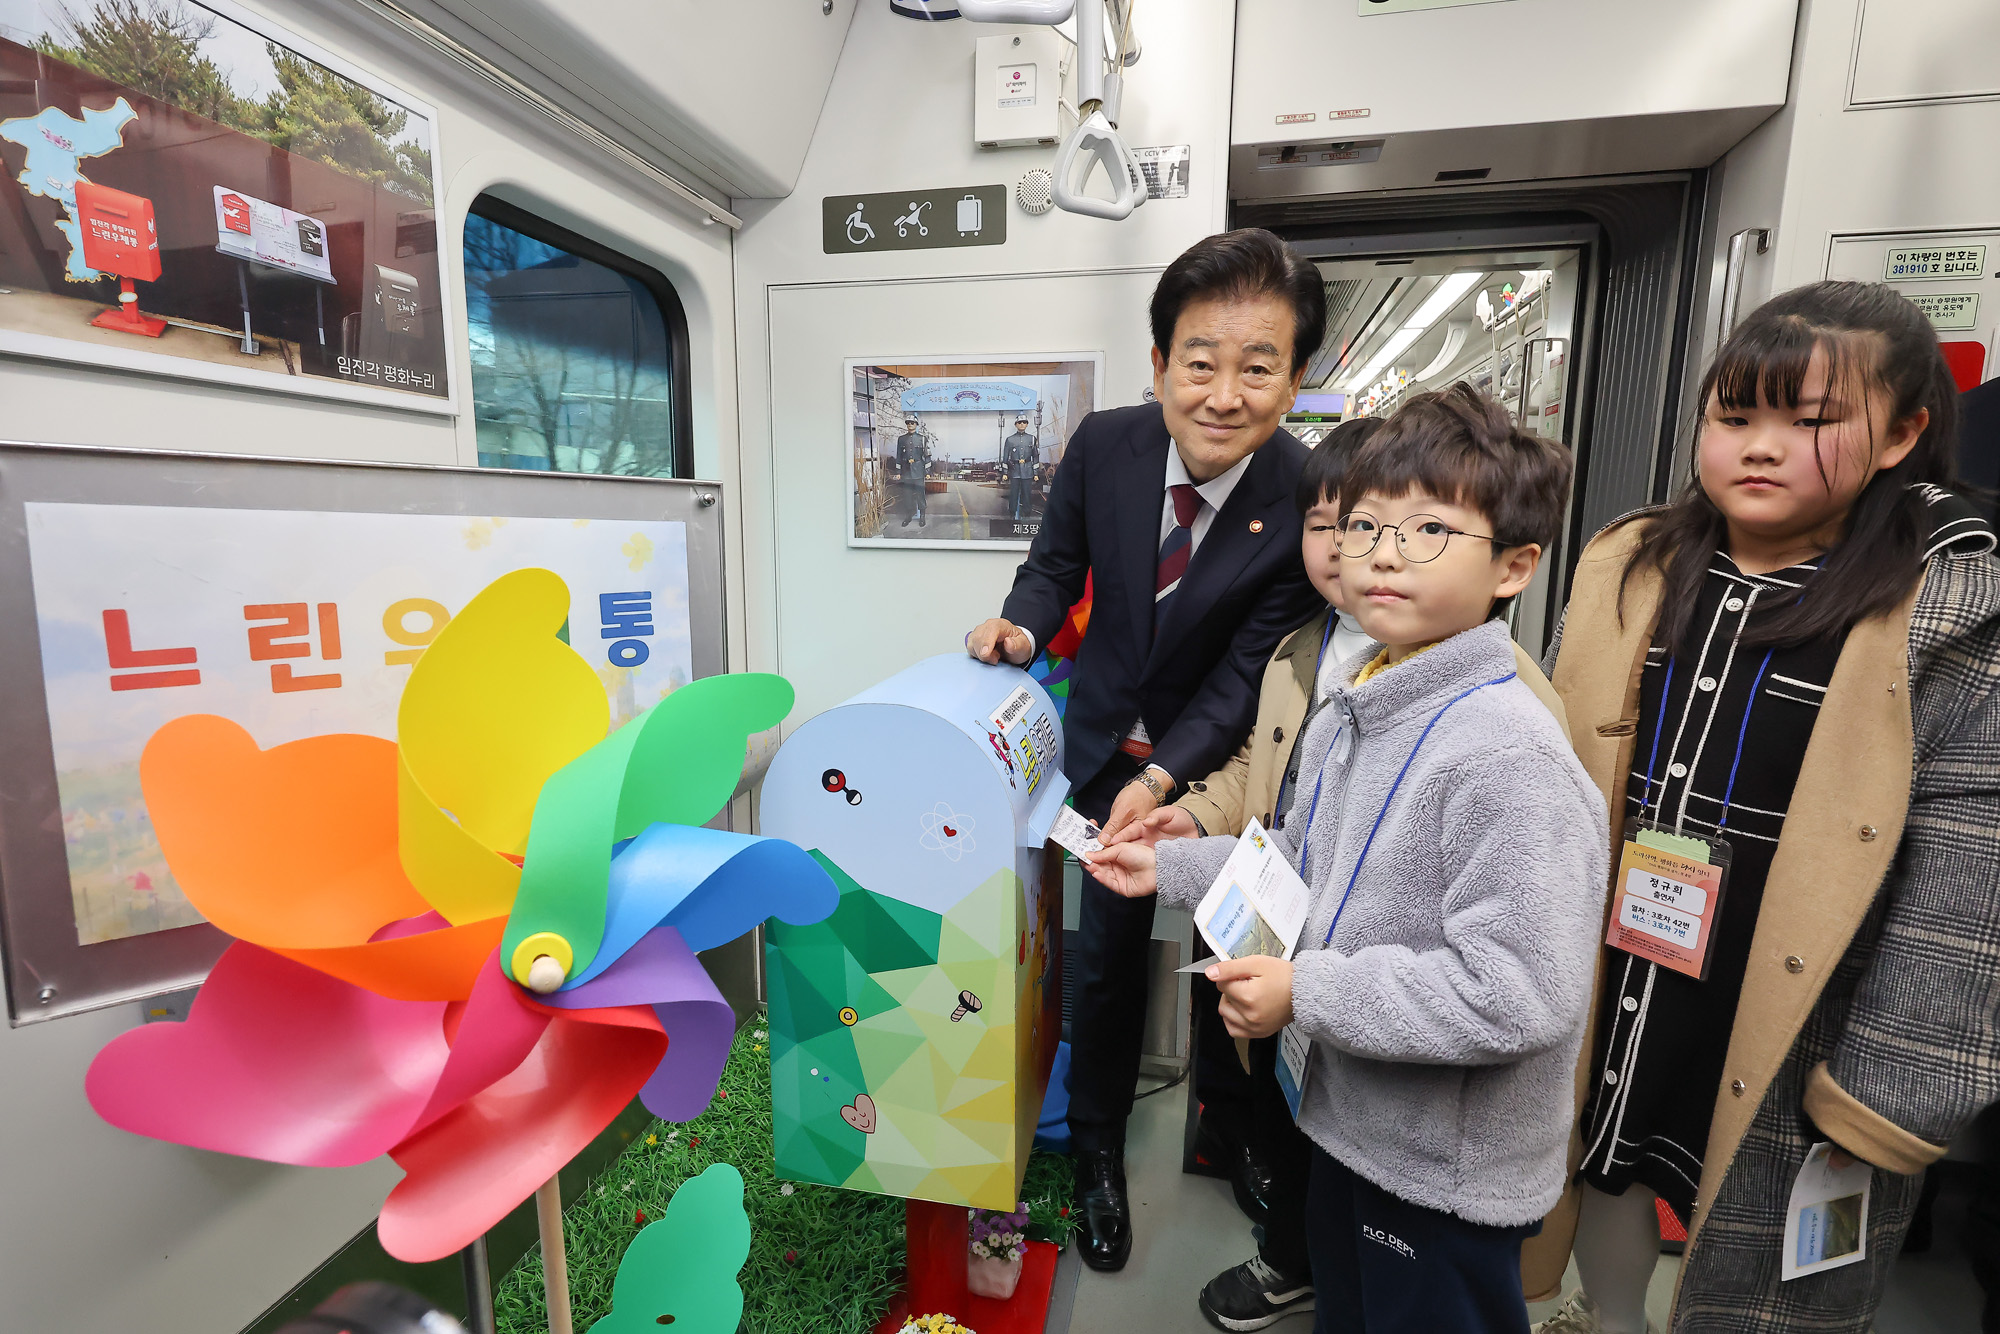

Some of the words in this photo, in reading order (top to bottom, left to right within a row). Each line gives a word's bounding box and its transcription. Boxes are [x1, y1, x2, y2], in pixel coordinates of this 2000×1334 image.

[92, 227, 138, 248] 느린우체통
[1896, 254, 1906, 262] 이
[1910, 252, 1941, 261] 차량의
[1945, 251, 1977, 261] 번호는
[1893, 264, 1927, 274] 381910
[1930, 264, 1940, 272] 호
[1944, 262, 1979, 272] 입니다.
[337, 356, 380, 379] 임진각
[384, 365, 435, 390] 평화누리
[1013, 524, 1041, 534] 제3땅
[102, 591, 655, 693] 느린우통
[1681, 863, 1695, 873] 다시
[1654, 891, 1675, 904] 출연자
[1632, 904, 1645, 914] 열차
[1652, 911, 1671, 923] 3호차
[1672, 919, 1690, 930] 42번
[1632, 914, 1646, 923] 버스
[1652, 921, 1671, 933] 3호차
[1674, 928, 1686, 938] 7번
[1363, 1225, 1385, 1240] FLC
[1388, 1233, 1416, 1259] DEPT.
